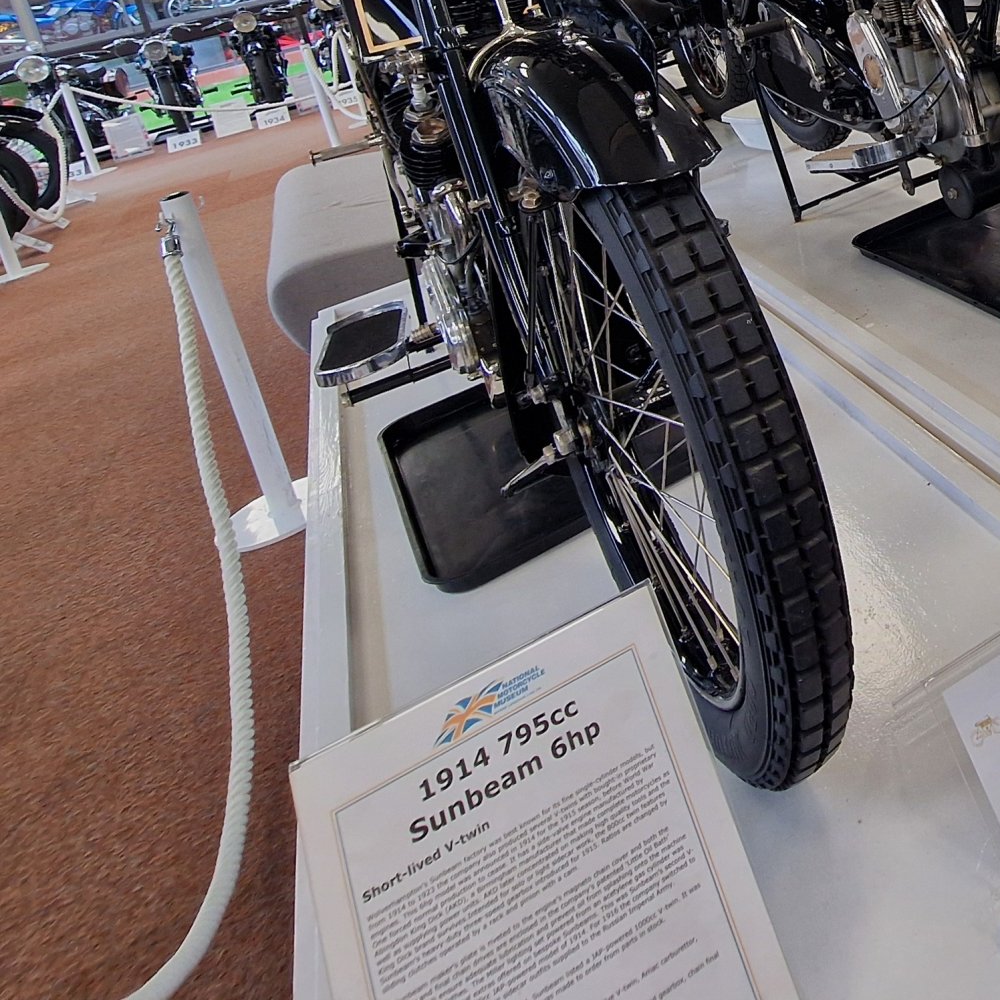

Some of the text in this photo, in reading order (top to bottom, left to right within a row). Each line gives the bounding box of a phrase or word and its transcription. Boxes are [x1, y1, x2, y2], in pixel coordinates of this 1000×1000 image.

[263, 115, 286, 126] 1934
[497, 669, 545, 699] MOTORCYCLE
[502, 665, 540, 689] NATIONAL
[494, 685, 529, 709] MUSEUM
[419, 700, 579, 802] 1914 795cc
[409, 721, 601, 843] Sunbeam 6hp
[361, 820, 491, 904] Short-lived V-twin
